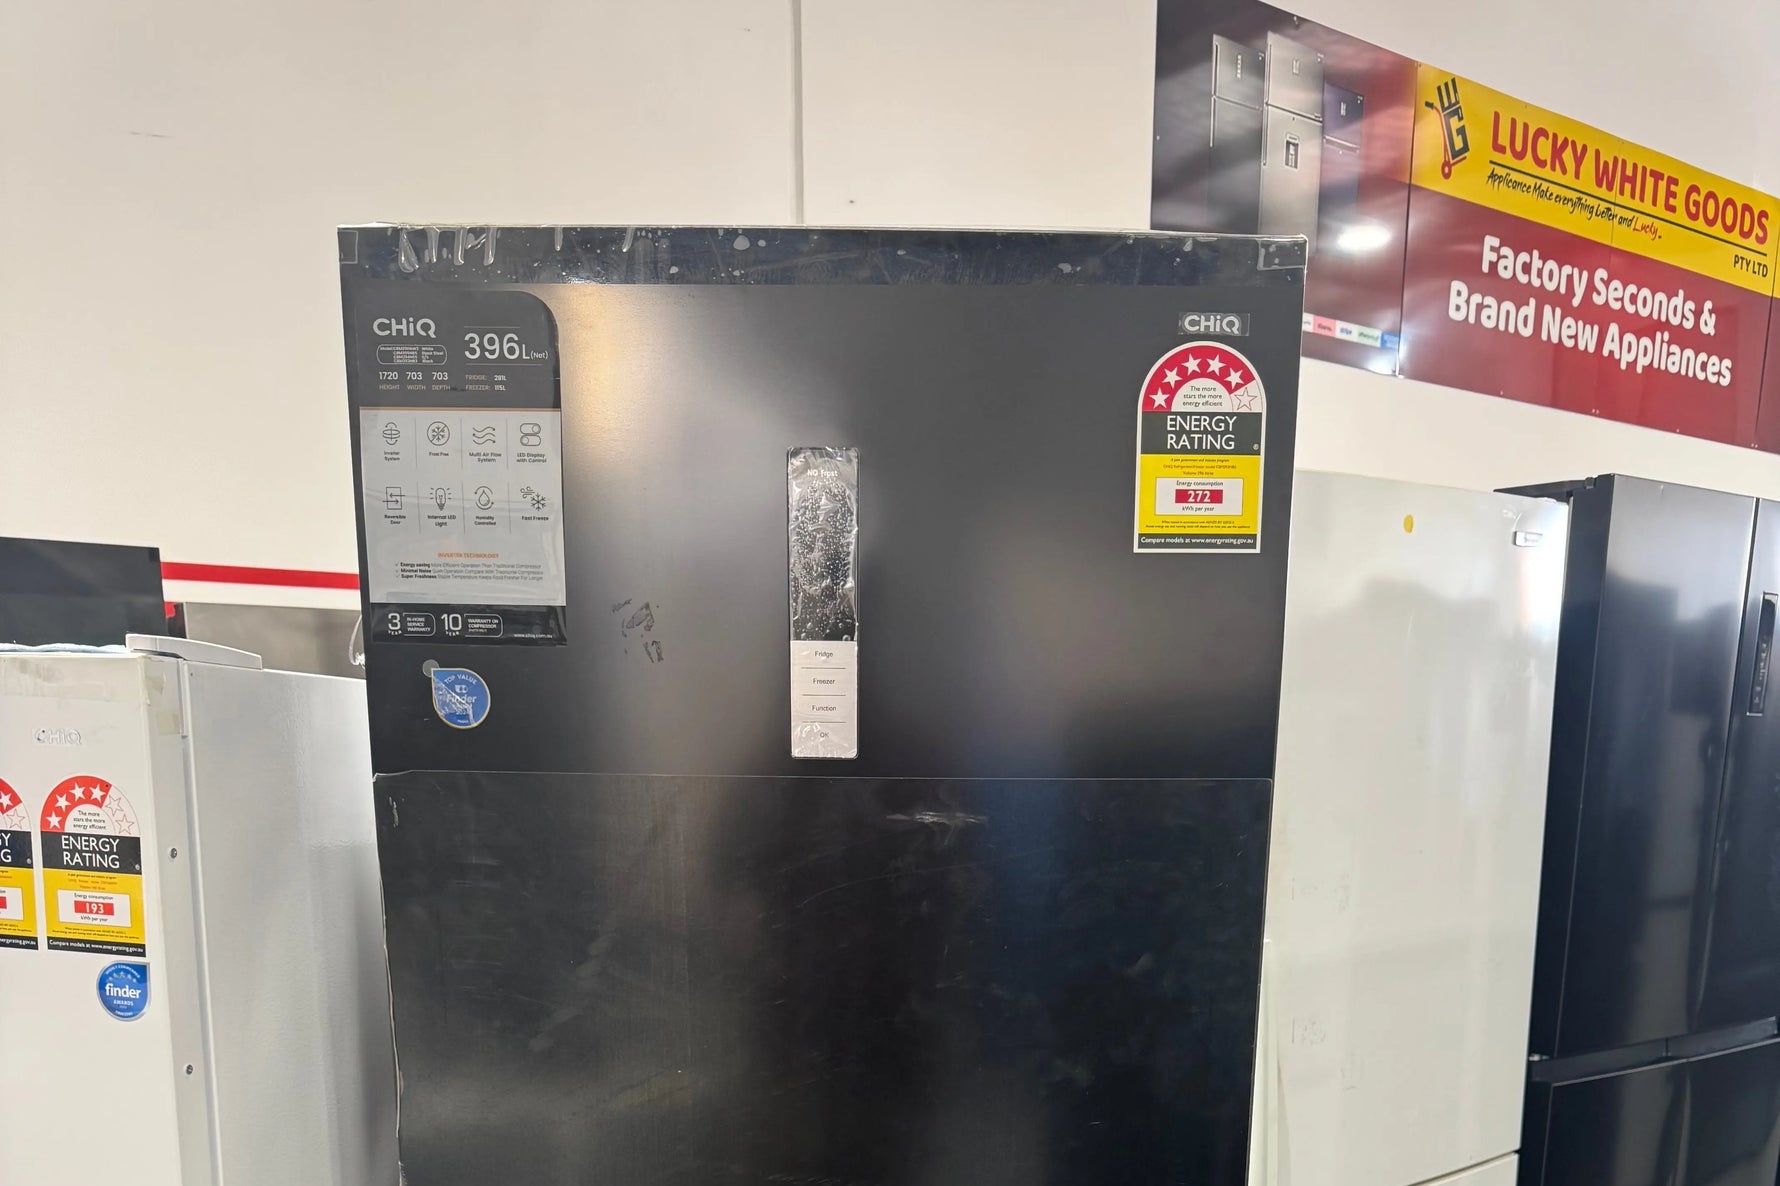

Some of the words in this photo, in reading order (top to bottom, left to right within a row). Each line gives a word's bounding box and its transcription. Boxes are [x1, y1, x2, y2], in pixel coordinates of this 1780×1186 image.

[1491, 111, 1588, 180] LUCKY
[1594, 148, 1679, 214] WHITE
[1684, 184, 1769, 245] GOODS
[1532, 183, 1554, 201] Make
[1554, 193, 1594, 221] everything
[1595, 204, 1617, 222] better
[1618, 215, 1635, 228] and
[1733, 254, 1751, 272] PTY
[1752, 261, 1768, 278] LTD
[1482, 234, 1589, 307] Factory
[1592, 268, 1695, 329] Seconds
[1700, 300, 1716, 336] &
[372, 317, 437, 338] CHiQ
[1184, 314, 1240, 335] CHiQ
[1448, 280, 1536, 338] Brand
[1541, 304, 1599, 353] New
[1602, 322, 1732, 386] Appliances
[379, 371, 399, 380] 1720
[406, 371, 423, 381] 703
[431, 371, 449, 381] 703
[1167, 415, 1238, 432] ENERGY
[1167, 433, 1235, 450] RATING
[1187, 490, 1211, 503] 272
[1141, 536, 1164, 544] Compare
[388, 613, 401, 630] 3
[441, 613, 462, 631] 10
[814, 650, 834, 658] Fridge
[61, 835, 120, 852] ENERGY
[63, 851, 120, 869] RATING
[85, 903, 104, 914] 193
[105, 983, 141, 999] finder
